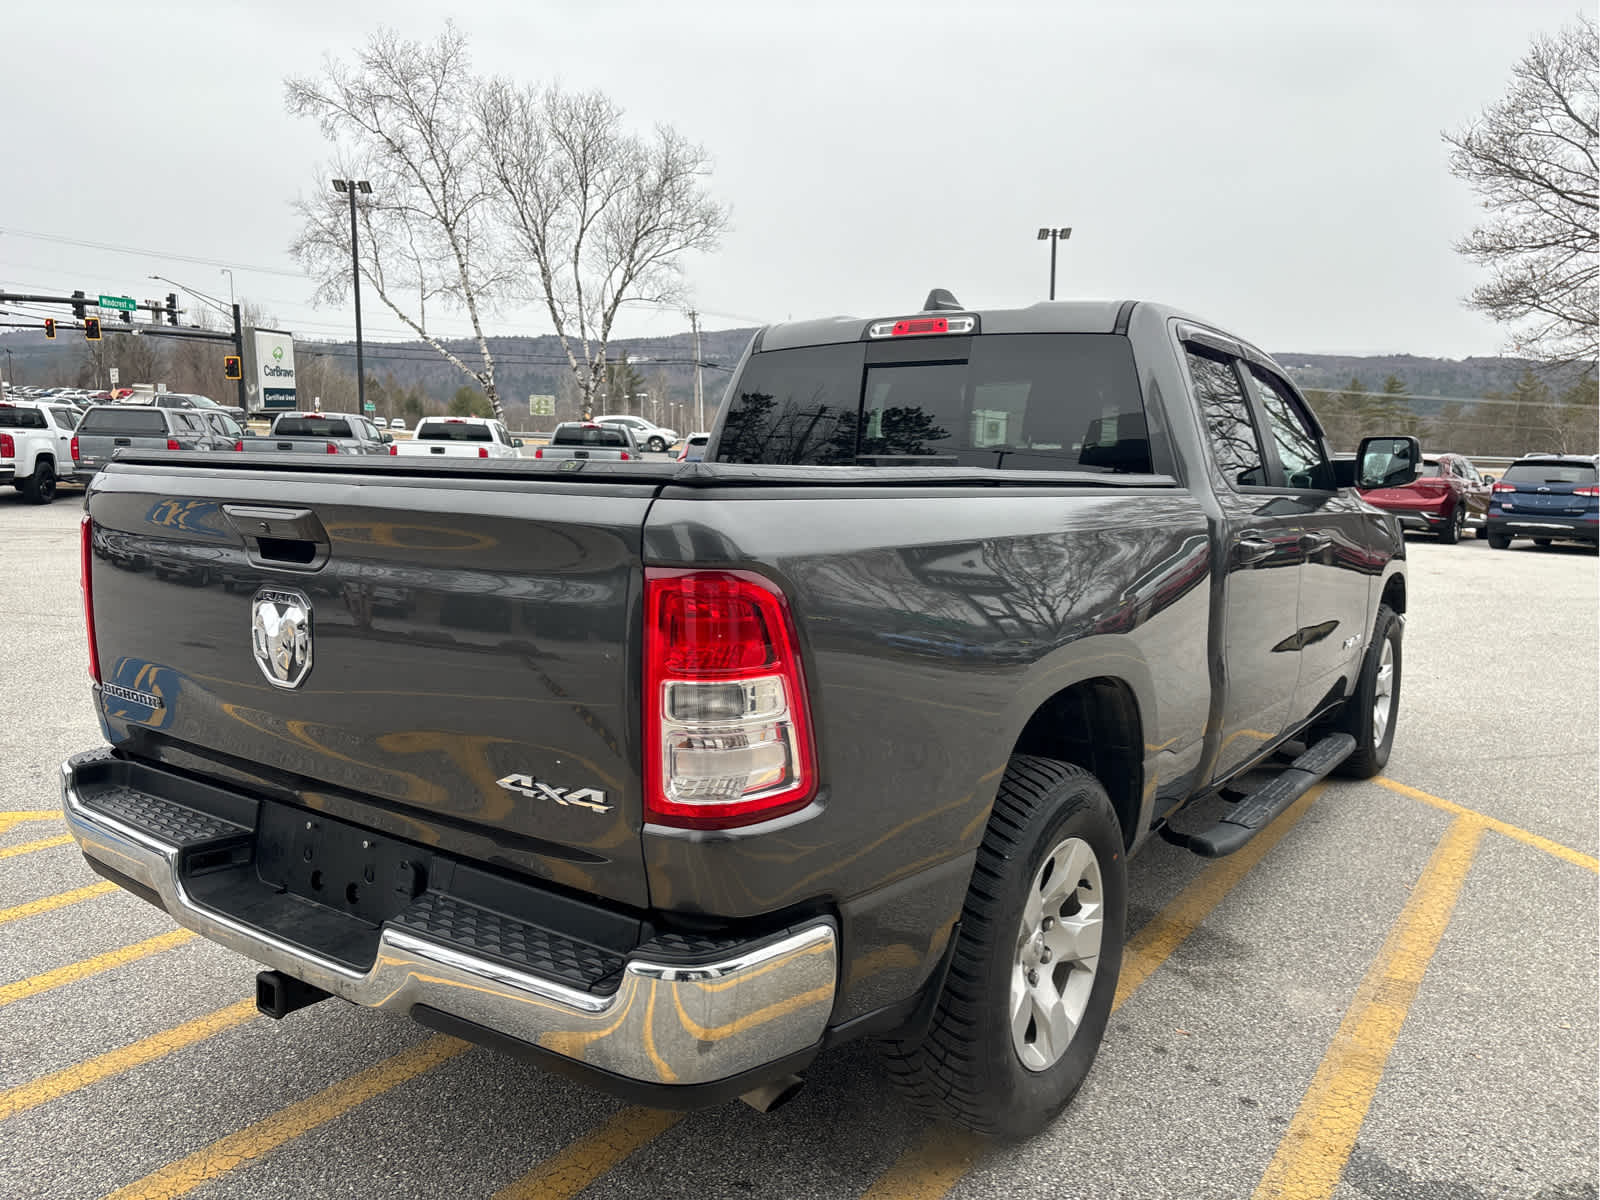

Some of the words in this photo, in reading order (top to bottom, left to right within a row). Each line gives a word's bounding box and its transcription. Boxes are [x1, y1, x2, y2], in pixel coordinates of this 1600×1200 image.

[102, 298, 127, 308] Windcrest
[264, 364, 294, 377] CarBravo
[265, 393, 285, 401] Certified
